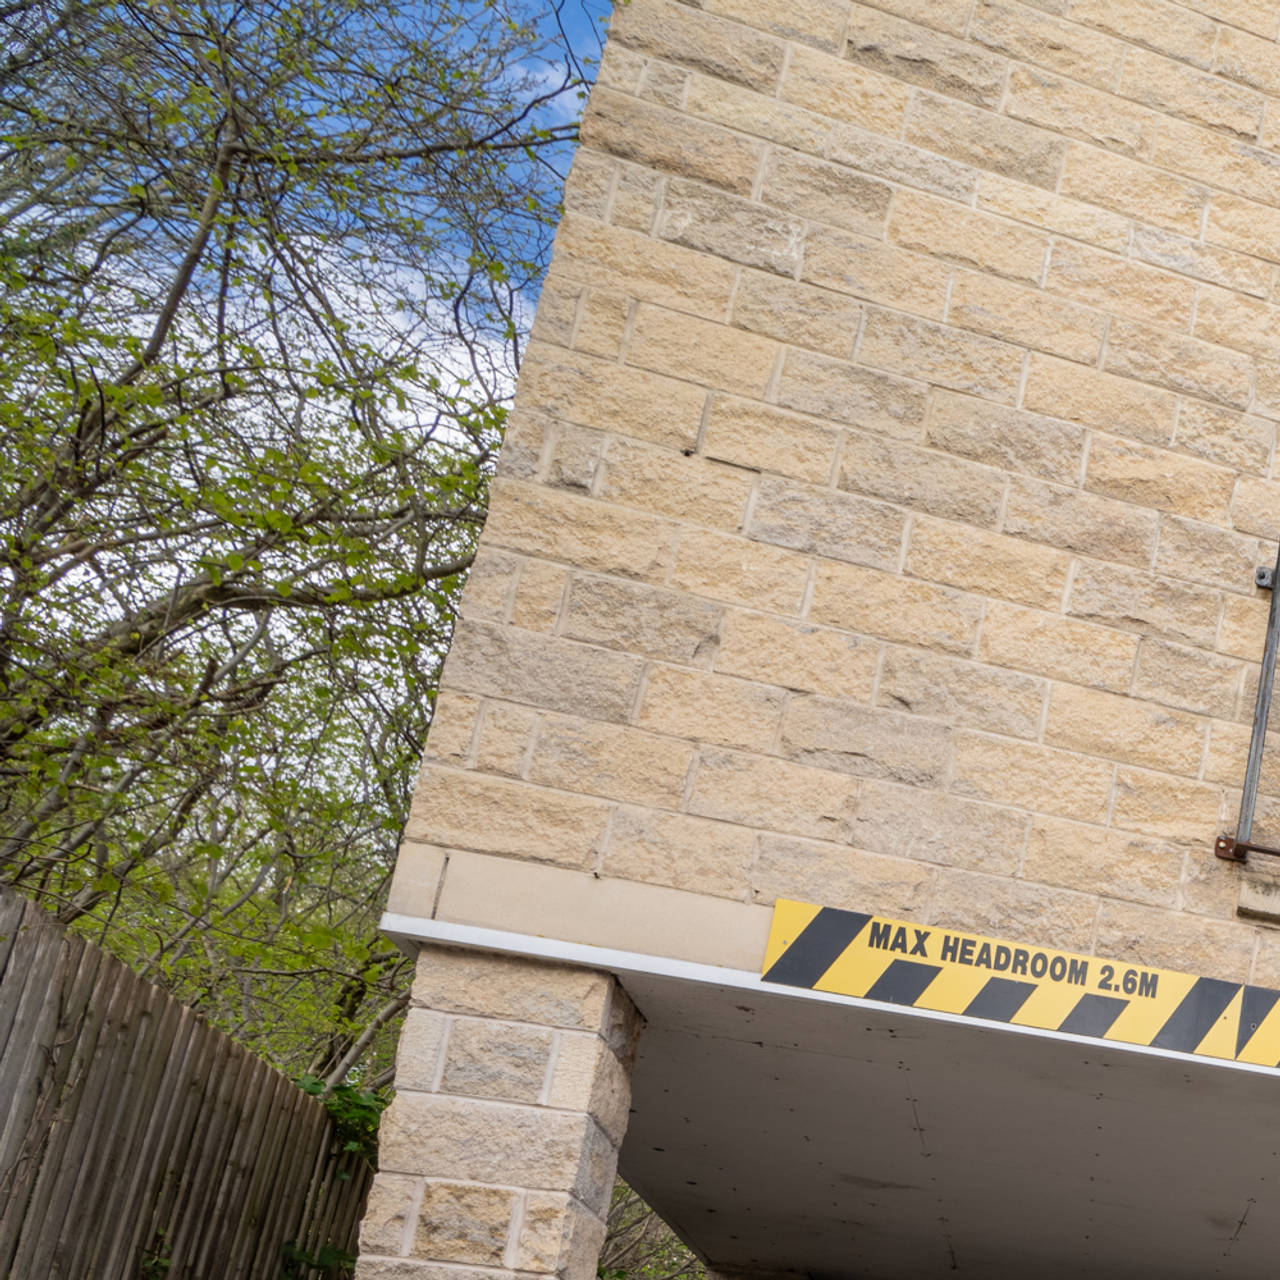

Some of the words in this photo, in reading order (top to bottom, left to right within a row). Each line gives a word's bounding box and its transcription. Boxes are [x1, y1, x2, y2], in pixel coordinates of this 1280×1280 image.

[868, 922, 931, 957] MAX
[941, 935, 1089, 986] HEADROOM
[1098, 965, 1159, 998] 2.6M
